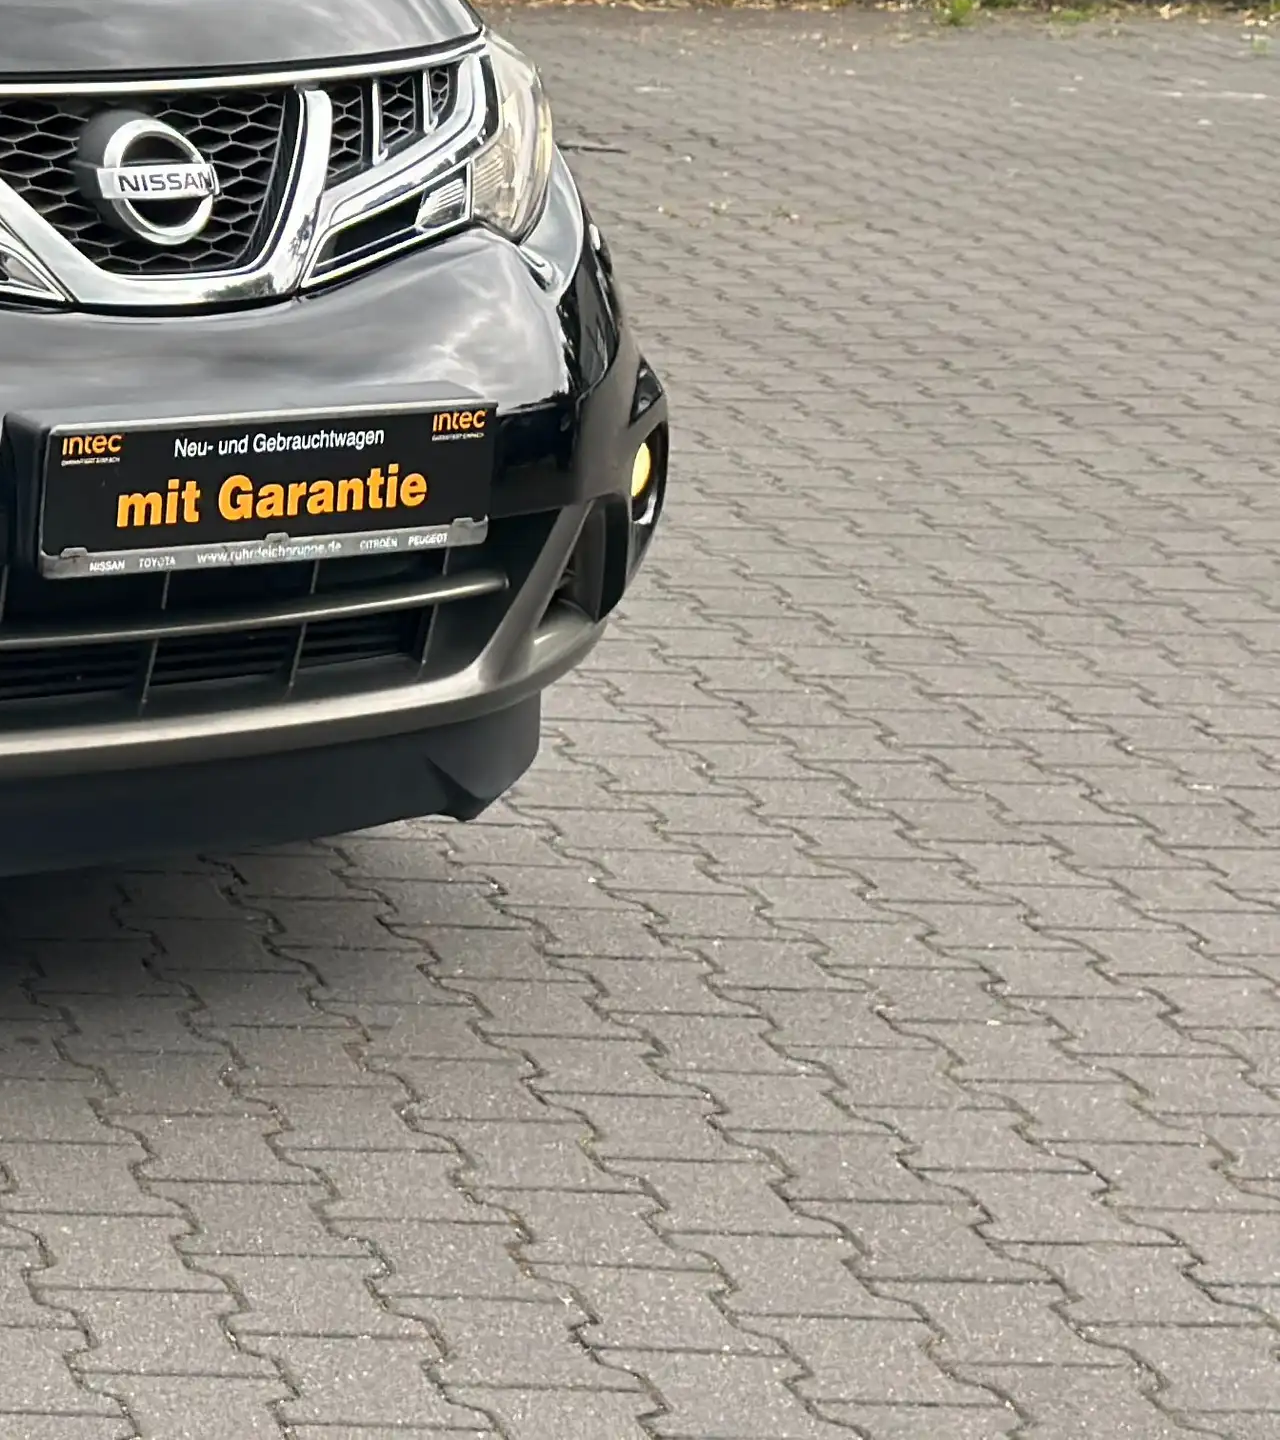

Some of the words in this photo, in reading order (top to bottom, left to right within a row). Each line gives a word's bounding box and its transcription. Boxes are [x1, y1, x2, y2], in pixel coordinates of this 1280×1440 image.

[117, 171, 213, 193] NISSAN
[173, 437, 214, 458] Neu-
[217, 433, 249, 455] und
[252, 428, 385, 453] Gebrauchtwagen
[116, 478, 201, 528] mit
[218, 463, 428, 521] Garantie
[89, 559, 126, 572] NISSAN
[139, 555, 176, 569] TOYOTA
[407, 531, 449, 547] PEUGEOT
